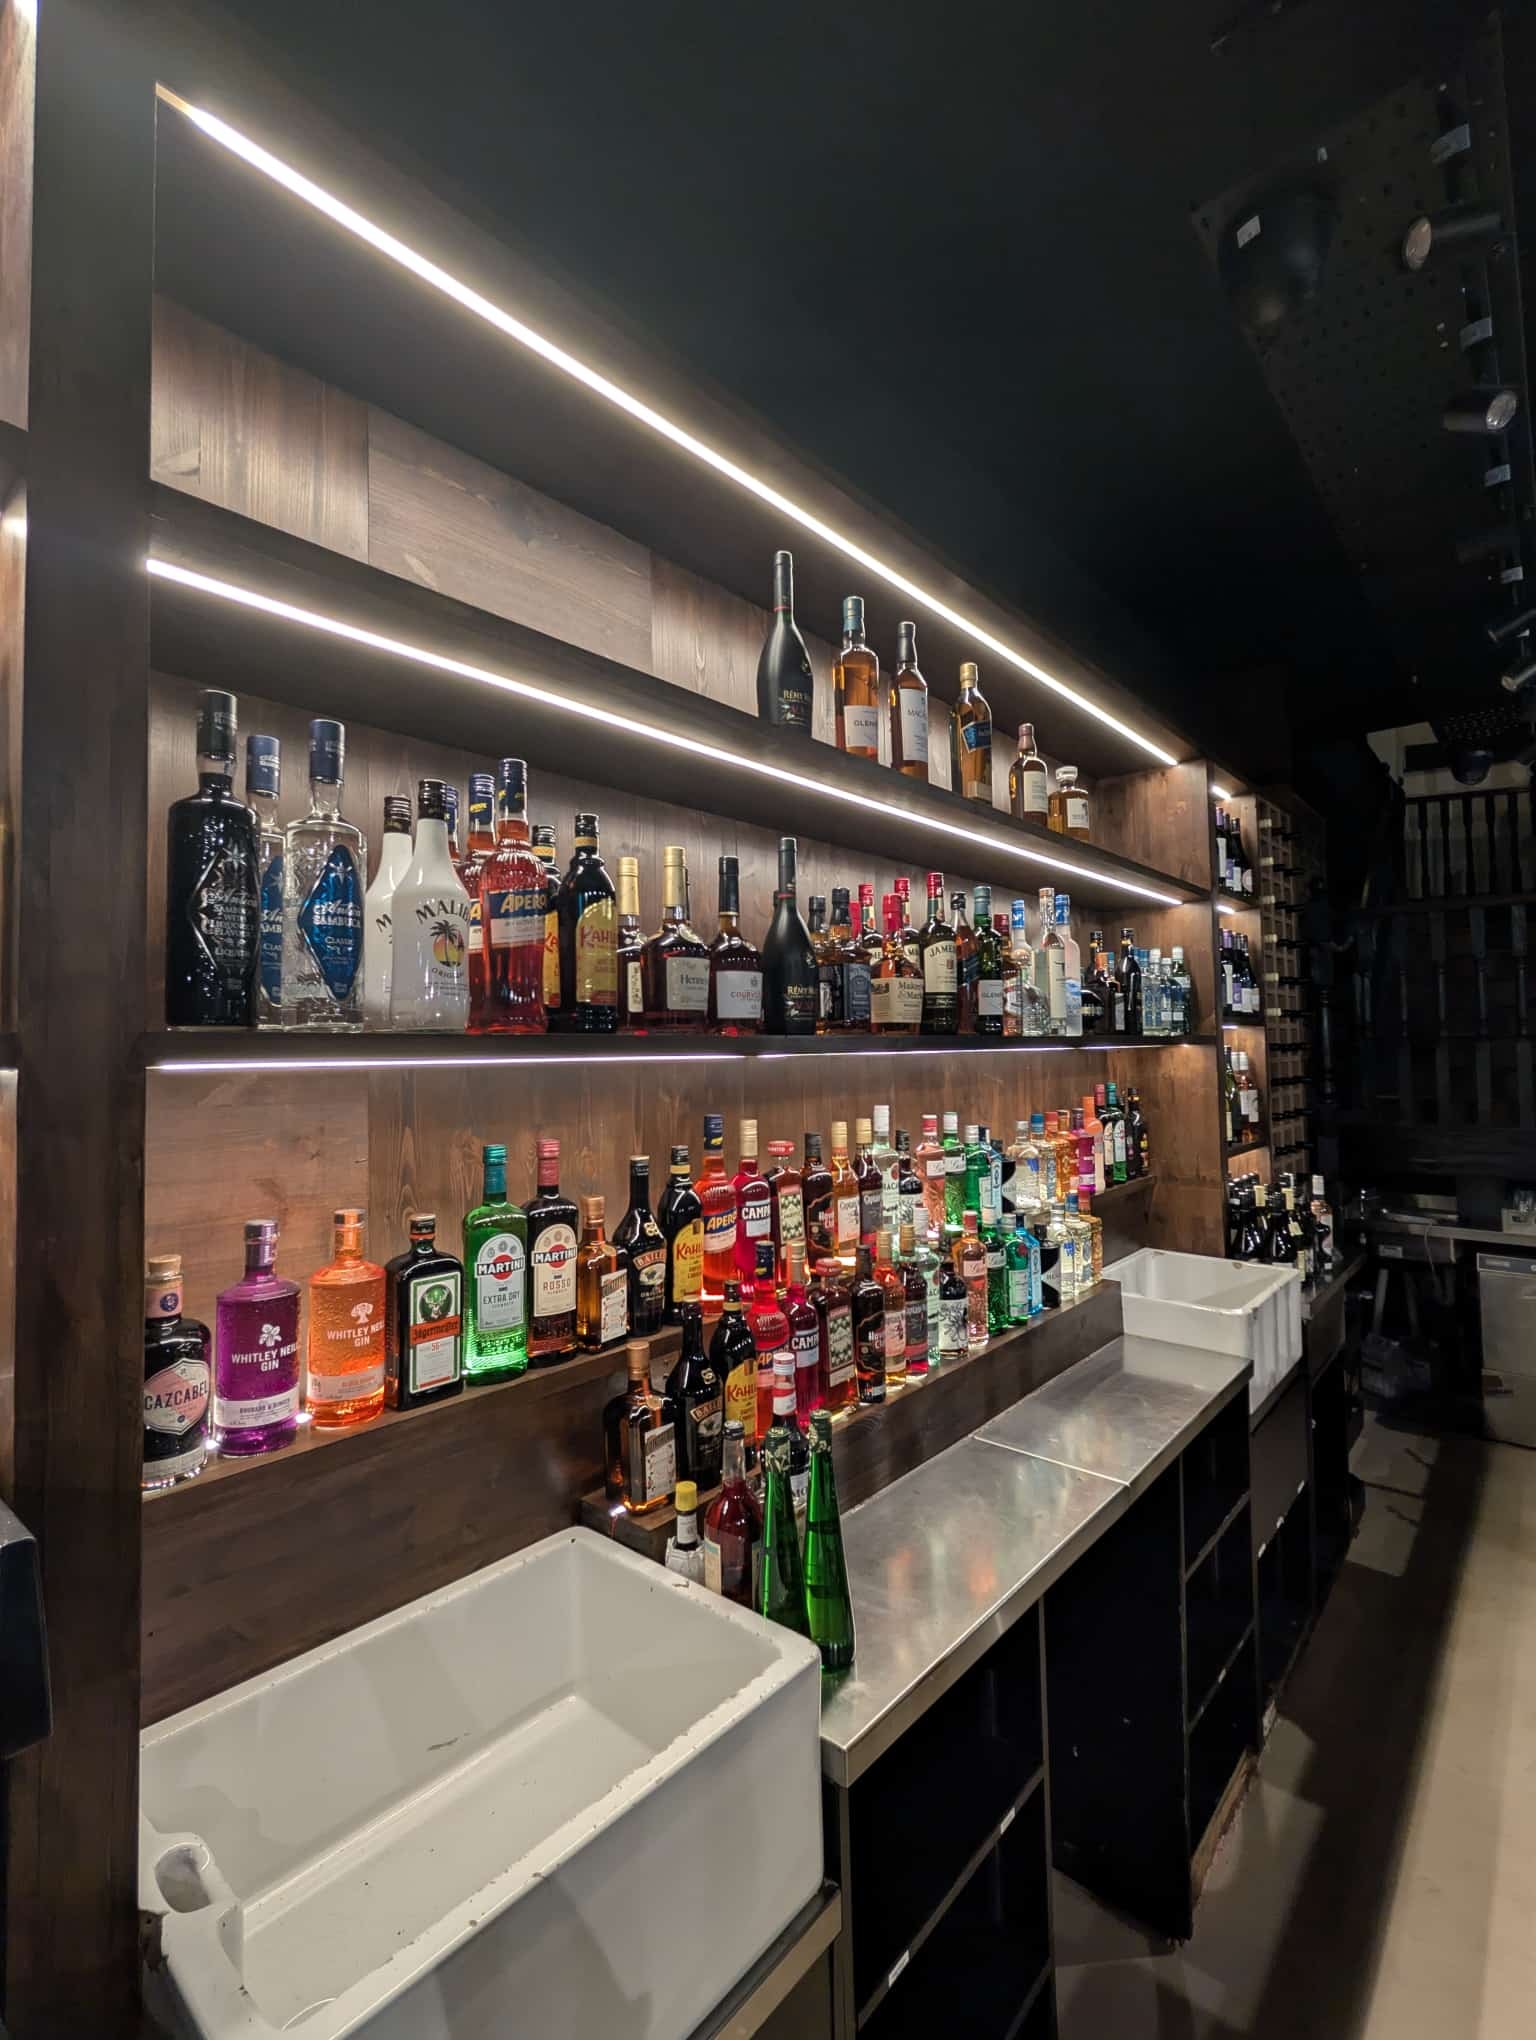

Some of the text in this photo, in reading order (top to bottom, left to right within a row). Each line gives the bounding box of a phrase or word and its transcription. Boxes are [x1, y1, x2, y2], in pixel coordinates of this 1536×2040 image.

[501, 893, 547, 913] APERO
[535, 1246, 577, 1261] MARTINI
[478, 1258, 524, 1275] MARTINI
[543, 1278, 571, 1289] ROSSO
[483, 1294, 507, 1304] EXTRA
[327, 1327, 369, 1341] WHITLEY
[354, 1336, 371, 1347] GIN
[231, 1350, 278, 1365] WHITLEY
[260, 1360, 279, 1373] GIN
[144, 1380, 209, 1410] CAZCABEL
